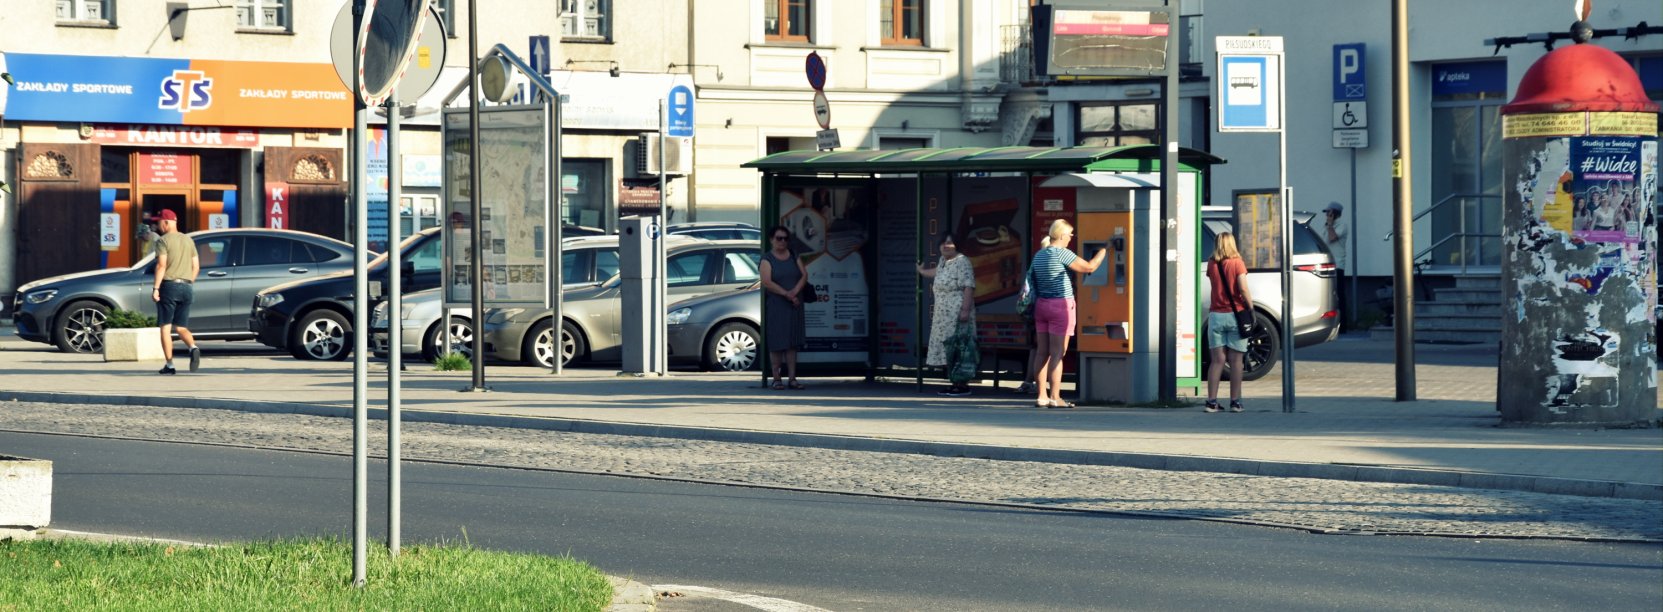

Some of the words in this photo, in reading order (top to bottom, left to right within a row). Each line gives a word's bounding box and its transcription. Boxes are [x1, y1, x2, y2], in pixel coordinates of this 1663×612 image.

[1340, 48, 1359, 84] P
[1446, 71, 1470, 82] apteka
[16, 81, 69, 93] ZAKŁADY
[72, 85, 133, 95] SPORTOWE
[159, 71, 212, 112] STS
[239, 88, 288, 99] ZAKŁADY
[291, 90, 347, 101] SPORTOWE
[127, 125, 222, 146] KANTOR
[1582, 140, 1604, 148] Studiuj
[1612, 139, 1637, 149] Świdnicy!
[1581, 154, 1637, 176] #Widzę
